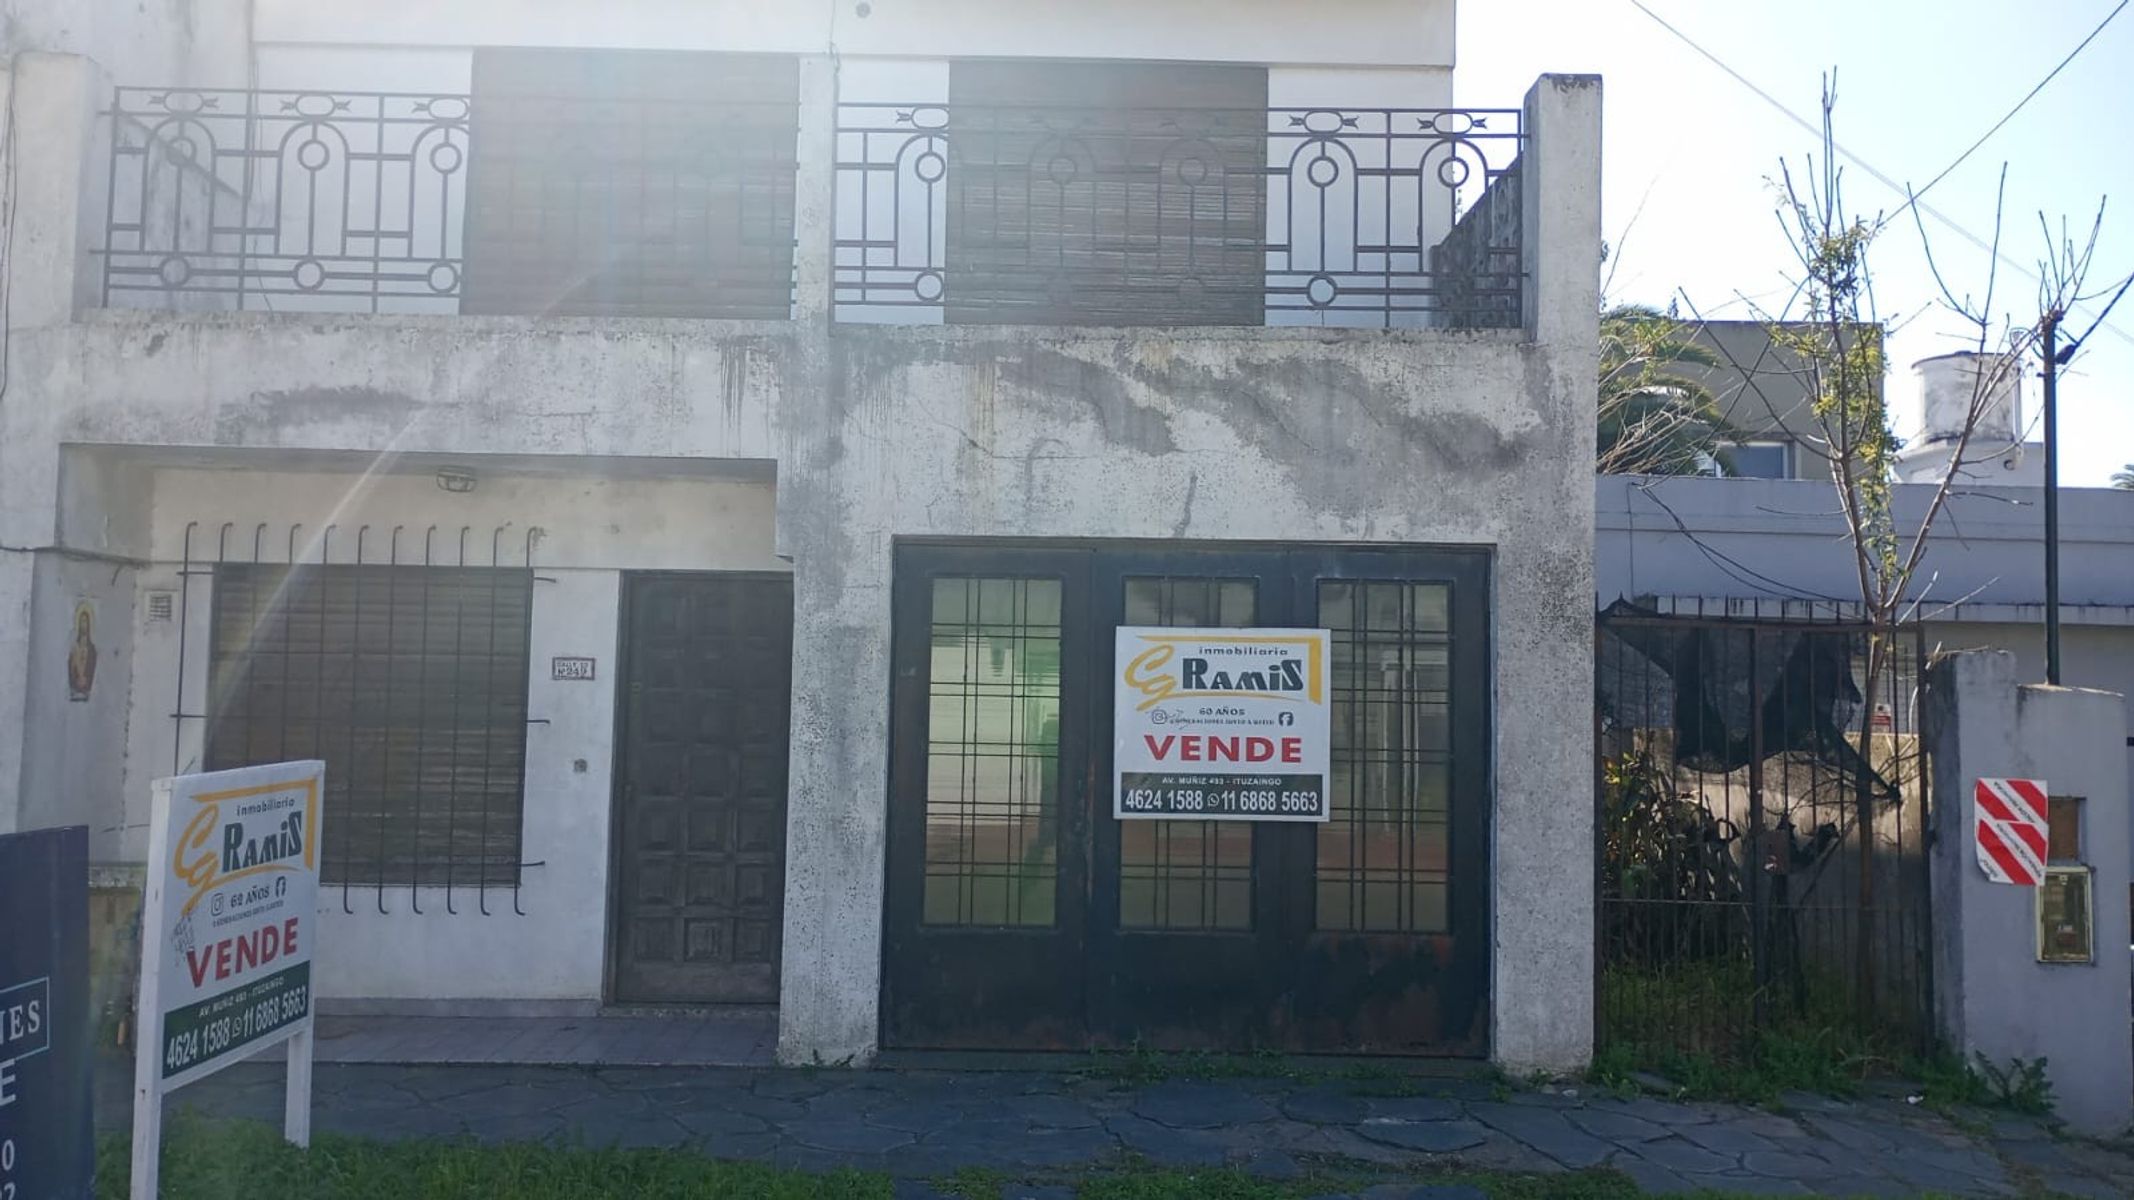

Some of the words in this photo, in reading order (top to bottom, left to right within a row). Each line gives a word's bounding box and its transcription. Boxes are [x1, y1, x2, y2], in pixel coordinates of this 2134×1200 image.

[1199, 646, 1289, 656] inmobiliaria
[1214, 706, 1246, 717] AÑOS
[1143, 734, 1303, 763] VENDE
[236, 797, 295, 817] inmobiliaria
[1125, 789, 1163, 809] 4624
[1167, 790, 1204, 810] 1588
[1221, 790, 1236, 810] 11
[1239, 791, 1277, 811] 6868
[1281, 791, 1318, 811] 5663
[245, 884, 270, 906] AÑOS
[187, 917, 299, 989] VENDE
[166, 1027, 198, 1070] 4624
[202, 1016, 231, 1056] 1588
[242, 1010, 254, 1038] 11
[255, 996, 280, 1032] 6868
[282, 985, 306, 1020] 5663
